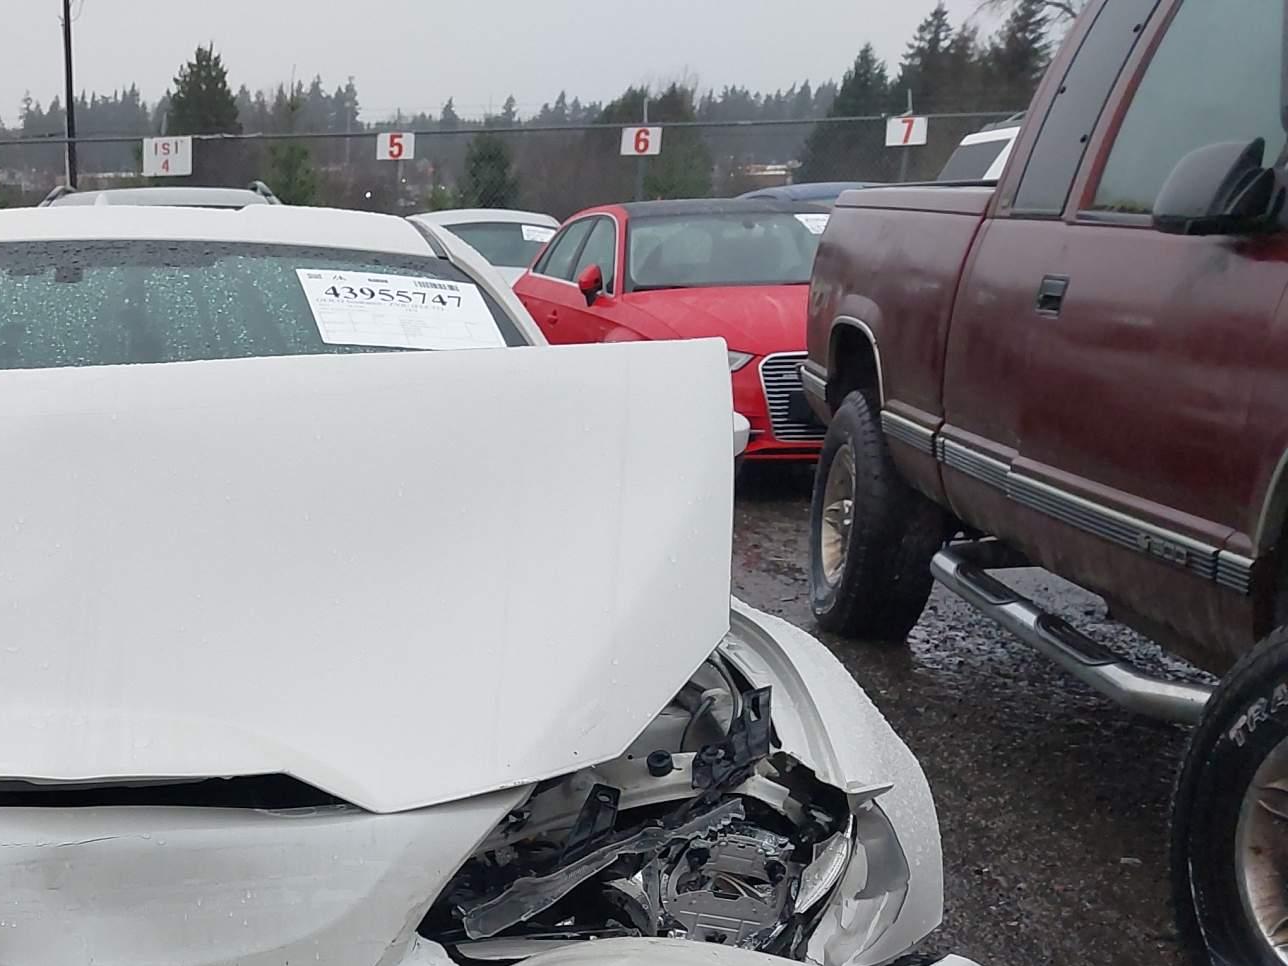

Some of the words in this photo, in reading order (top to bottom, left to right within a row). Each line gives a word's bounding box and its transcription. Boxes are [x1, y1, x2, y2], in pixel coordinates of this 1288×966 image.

[634, 128, 650, 154] 6
[901, 119, 915, 144] 7
[388, 133, 404, 159] 5
[161, 159, 170, 173] 4
[324, 285, 462, 308] 43955747
